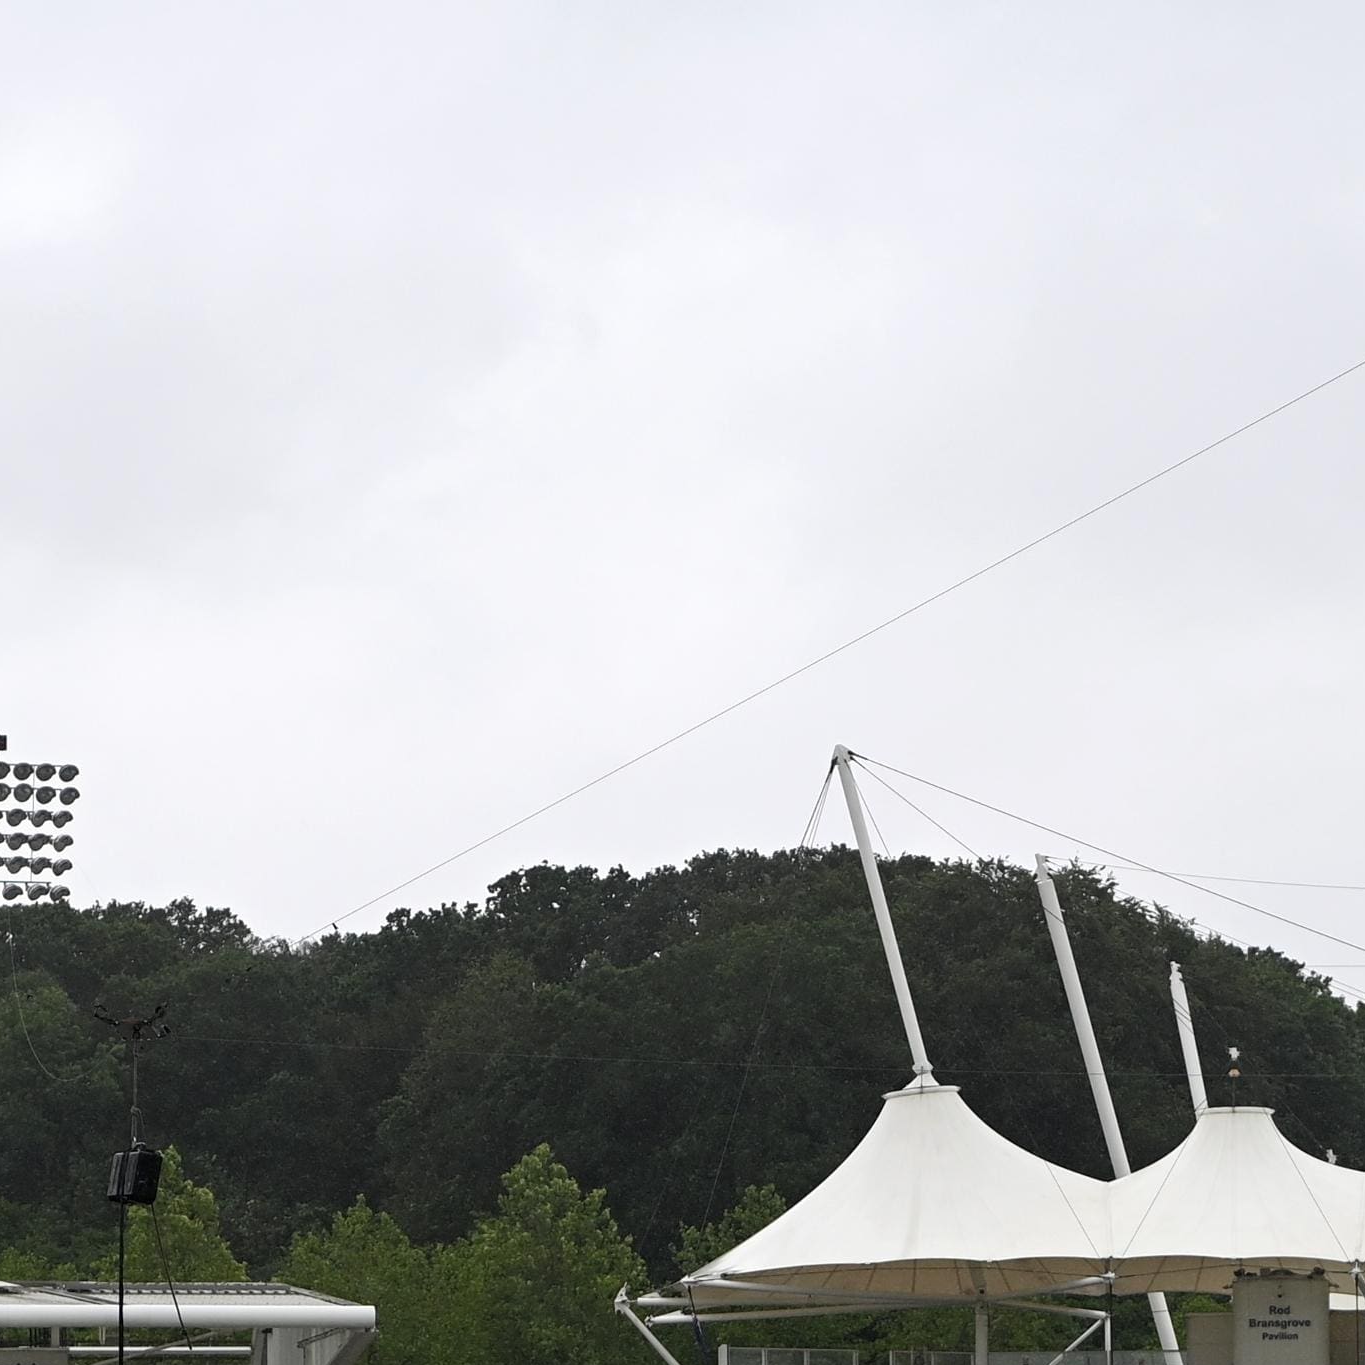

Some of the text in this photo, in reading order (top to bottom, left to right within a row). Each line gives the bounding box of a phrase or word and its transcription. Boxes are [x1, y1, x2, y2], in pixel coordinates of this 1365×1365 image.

[1269, 1305, 1290, 1315] Rod
[1249, 1319, 1311, 1329] Bransgrove
[1262, 1332, 1298, 1340] Pavilion
